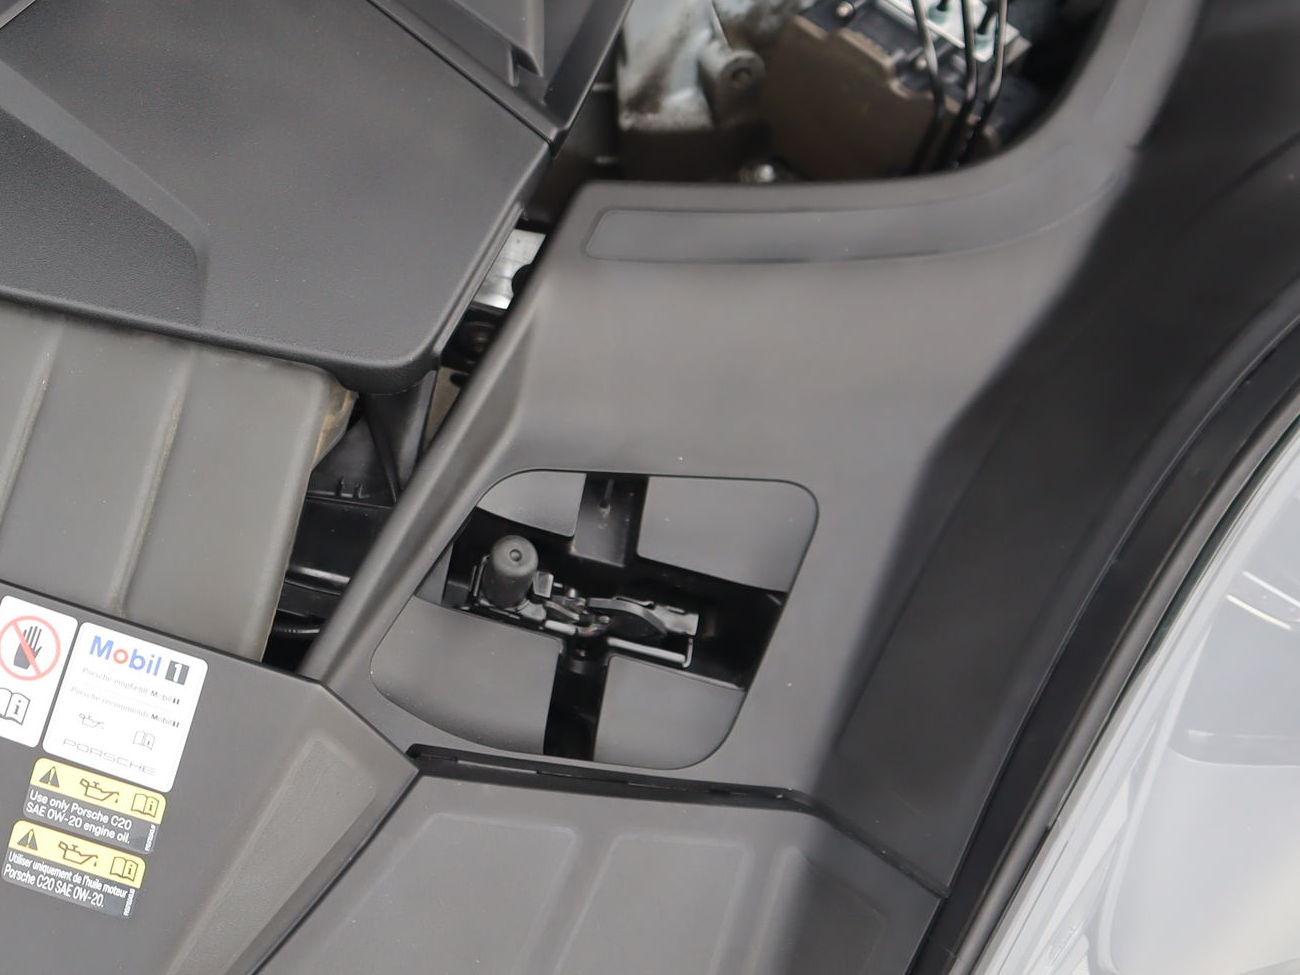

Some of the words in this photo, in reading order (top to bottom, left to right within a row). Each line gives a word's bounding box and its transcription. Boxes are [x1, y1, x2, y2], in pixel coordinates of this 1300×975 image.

[89, 635, 162, 676] Mobil
[63, 738, 156, 776] PORSCHE
[26, 802, 47, 817] SAE
[47, 808, 83, 828] 0W-20
[83, 822, 116, 839] engine
[117, 831, 130, 844] oil.
[29, 789, 48, 804] Use
[49, 798, 70, 813] only
[71, 803, 109, 823] Porsche
[110, 815, 132, 831] C20
[4, 863, 35, 885] Porsche
[36, 874, 55, 891] C20
[55, 881, 73, 898] SAE
[73, 886, 104, 908] 0W-20.
[8, 850, 33, 868] Utiliser
[33, 859, 72, 882] uniquement
[72, 872, 82, 884] de
[102, 884, 128, 898] moteur
